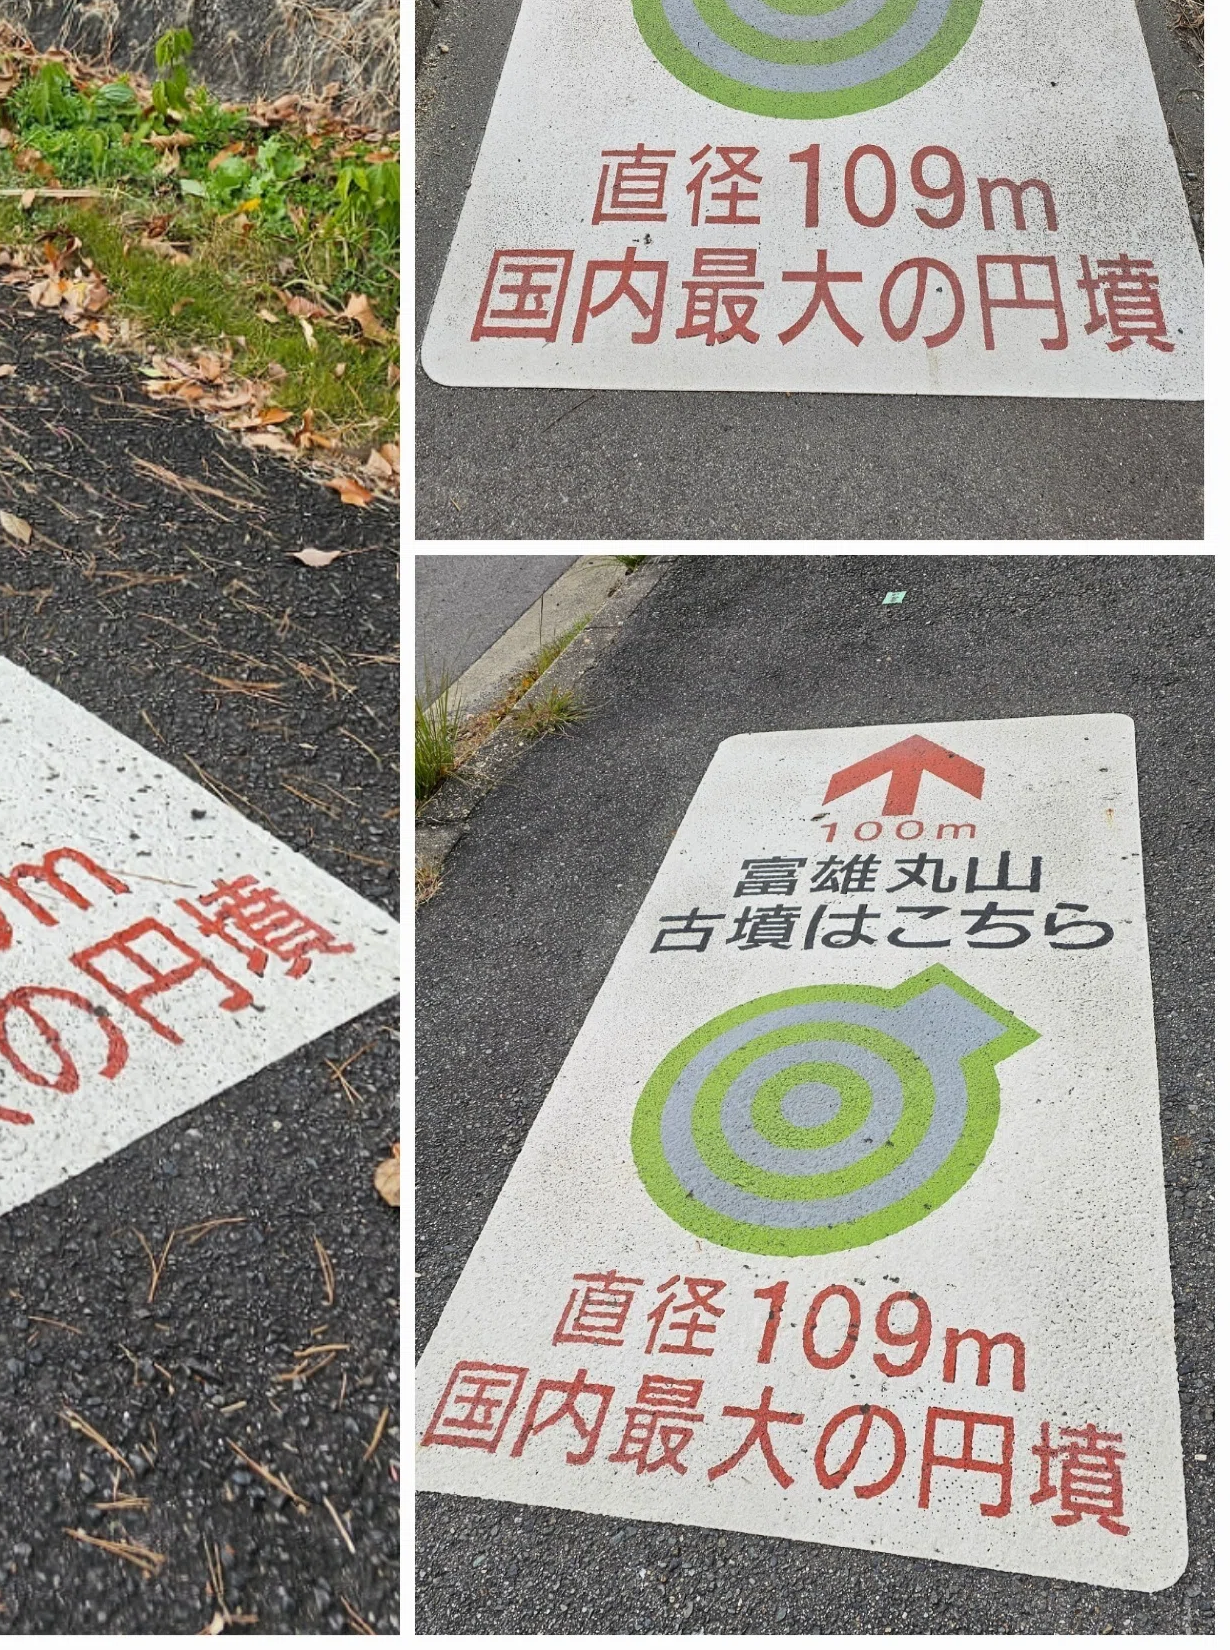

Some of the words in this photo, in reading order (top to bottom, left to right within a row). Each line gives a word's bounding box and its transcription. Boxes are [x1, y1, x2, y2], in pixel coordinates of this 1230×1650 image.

[469, 247, 1176, 354] 国内最大の円墳
[820, 819, 977, 843] 100m
[734, 851, 1043, 896] 富雄丸山
[649, 901, 1116, 953] 古墳はこちら
[420, 1360, 1130, 1536] 国内最大の円墳
